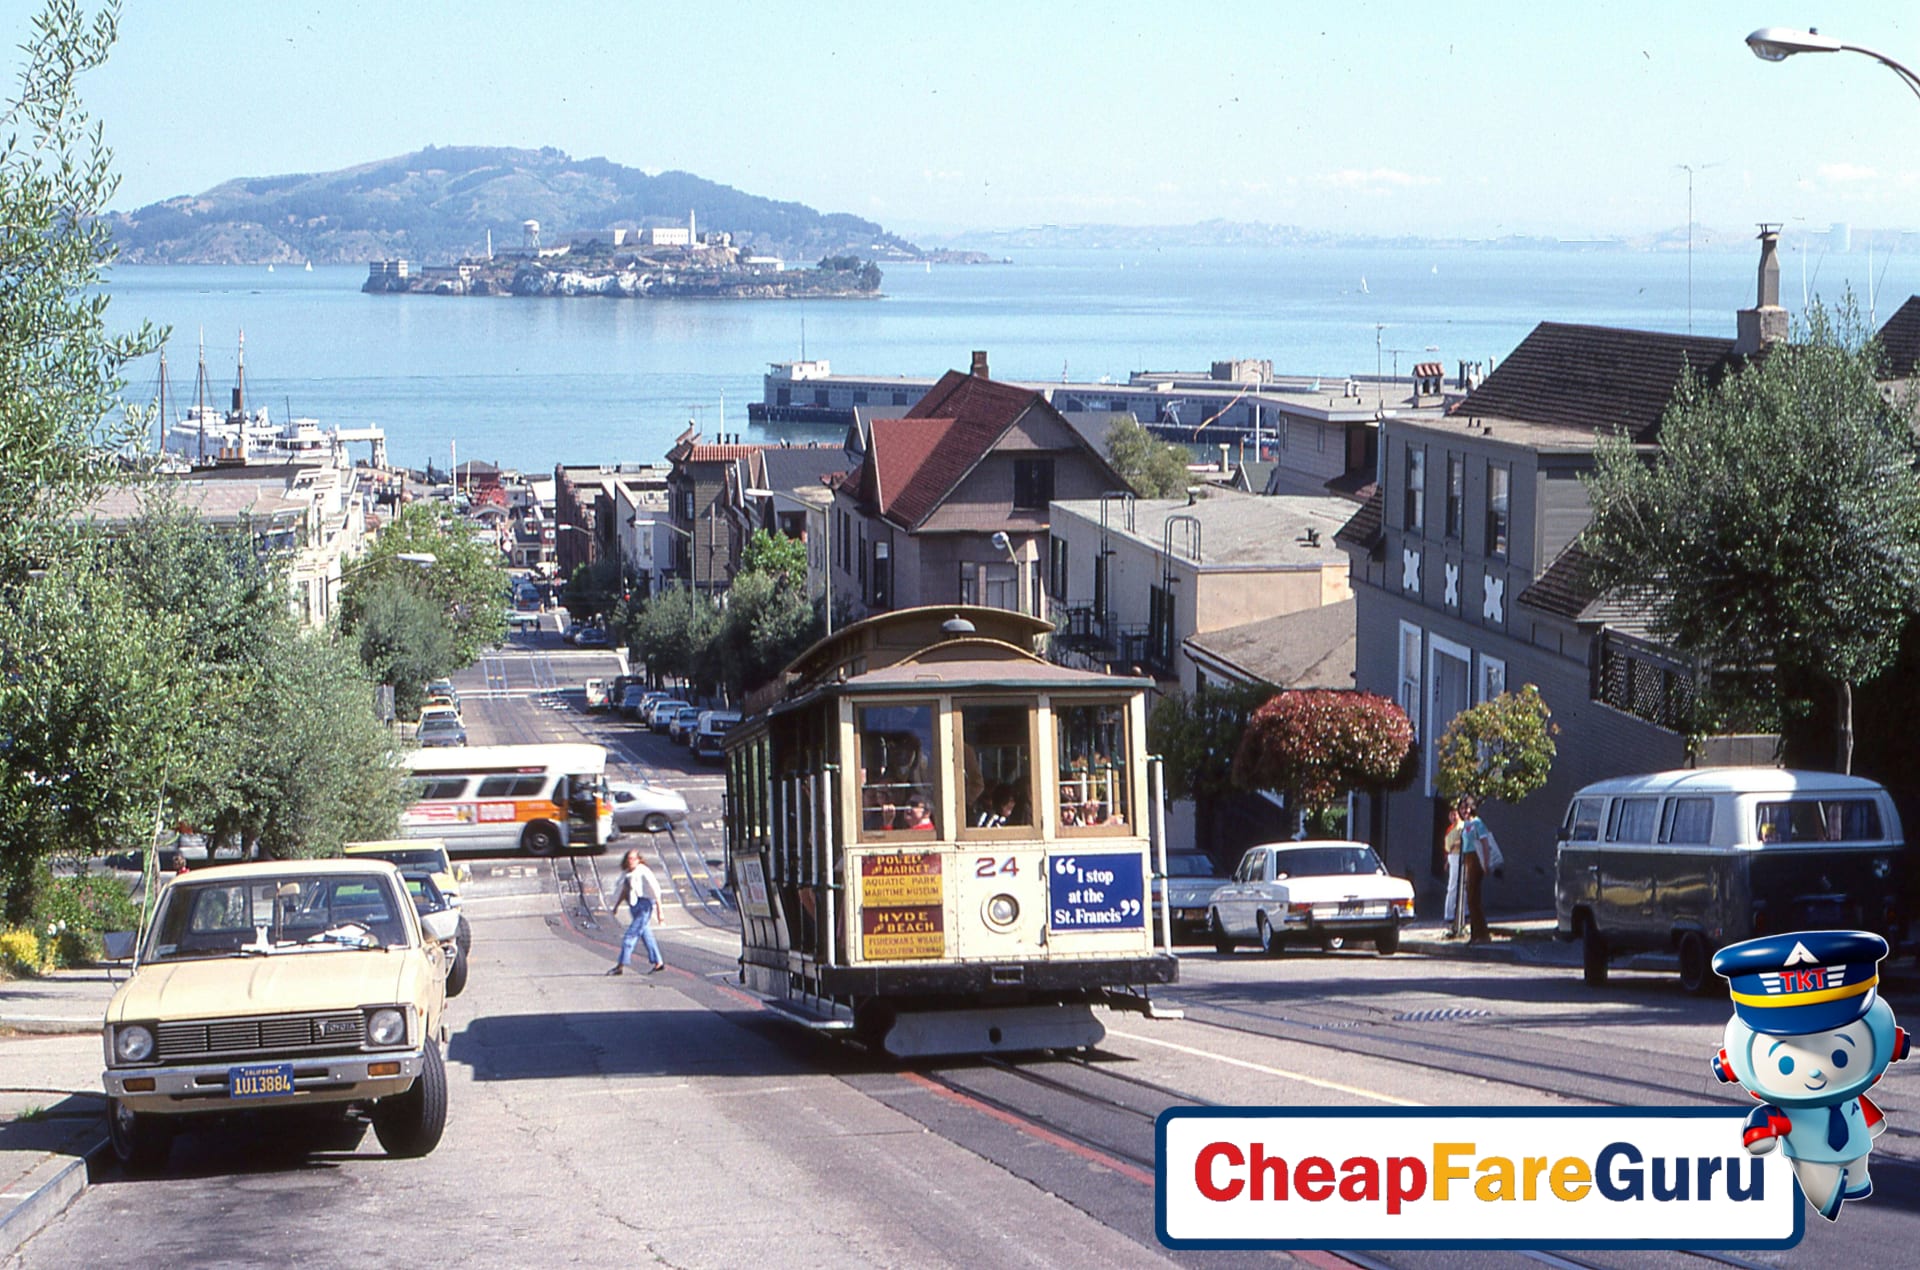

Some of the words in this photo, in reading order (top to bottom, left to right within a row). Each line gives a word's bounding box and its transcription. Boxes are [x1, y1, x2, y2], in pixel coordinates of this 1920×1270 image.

[883, 863, 930, 875] MARKET
[975, 856, 1020, 877] 24
[865, 877, 905, 886] AQUATIC
[912, 876, 936, 885] PARK
[1086, 869, 1114, 886] stop
[865, 888, 904, 896] MARITIME
[907, 887, 939, 896] MUSEUM
[1068, 890, 1082, 904] at
[1083, 888, 1104, 903] the
[878, 911, 929, 922] HYDE
[1055, 909, 1075, 924] St.
[887, 922, 934, 933] BEACH
[234, 1075, 291, 1095] 1U13884
